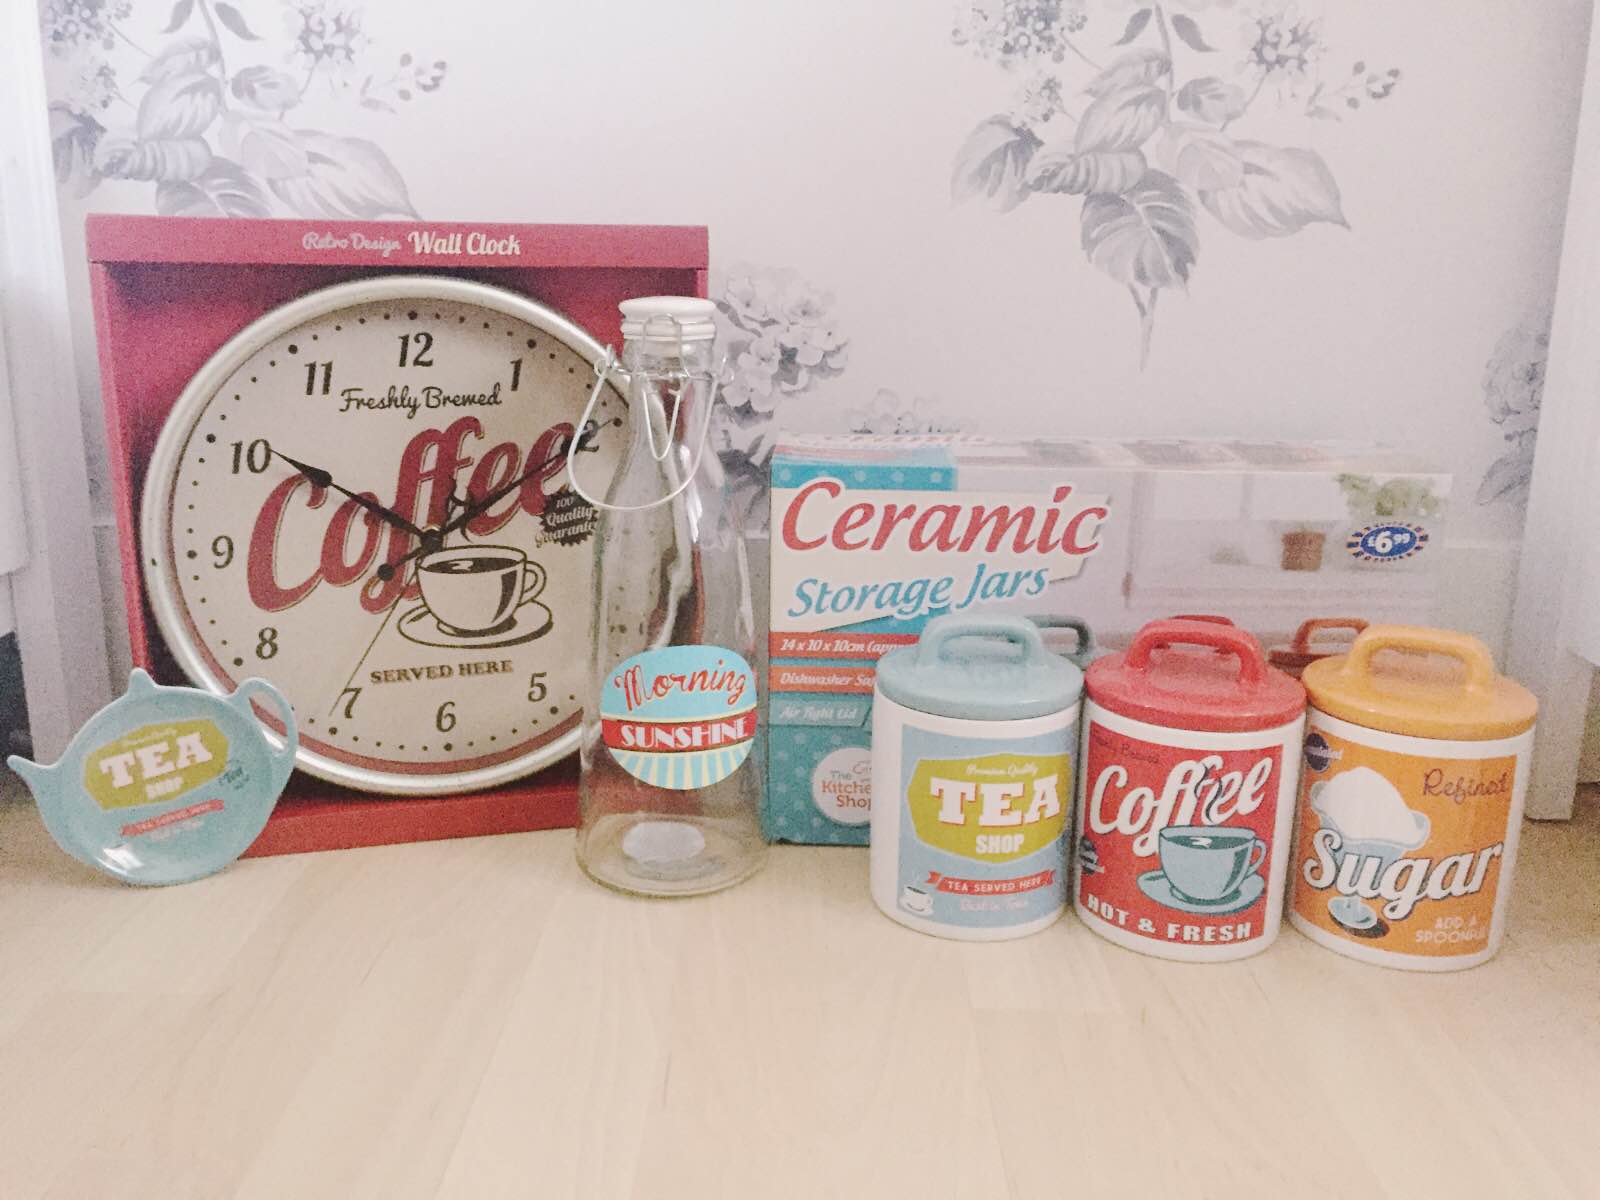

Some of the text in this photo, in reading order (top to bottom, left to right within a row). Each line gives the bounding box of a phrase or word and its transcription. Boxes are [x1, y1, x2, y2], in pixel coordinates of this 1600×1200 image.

[302, 231, 522, 257] Retro Design Wall Clock
[398, 331, 434, 368] 12
[304, 360, 333, 395] 11
[510, 357, 523, 392] 1
[338, 382, 503, 419] Freshly Brewed
[230, 438, 272, 475] 10
[246, 415, 576, 614] Coffee
[545, 505, 595, 526] Quality
[782, 481, 1108, 555] Ceramic
[211, 535, 234, 569] 9
[787, 563, 1050, 616] Storage Jars
[255, 626, 279, 660] 8
[780, 638, 797, 651] 14
[796, 642, 805, 651] x
[806, 639, 822, 651] 10
[821, 643, 830, 652] x
[833, 640, 864, 652] 10cm
[369, 660, 514, 685] SERVED HERE
[527, 671, 548, 703] 5
[614, 659, 747, 712] Morning
[780, 672, 852, 686] Dishwasher
[342, 687, 363, 719] 7
[435, 701, 458, 733] 6
[620, 716, 749, 749] SUNSHINE
[100, 731, 213, 789] TEA
[830, 770, 853, 780] The
[930, 774, 1061, 827] TEA
[1090, 755, 1274, 857] Coffee
[975, 833, 1025, 854] SHOP
[948, 880, 969, 893] TEA
[974, 882, 1016, 893] SERVED
[1303, 828, 1505, 921] Sugar
[1087, 893, 1252, 942] HOT & FRESH
[1434, 913, 1479, 930] ADD A
